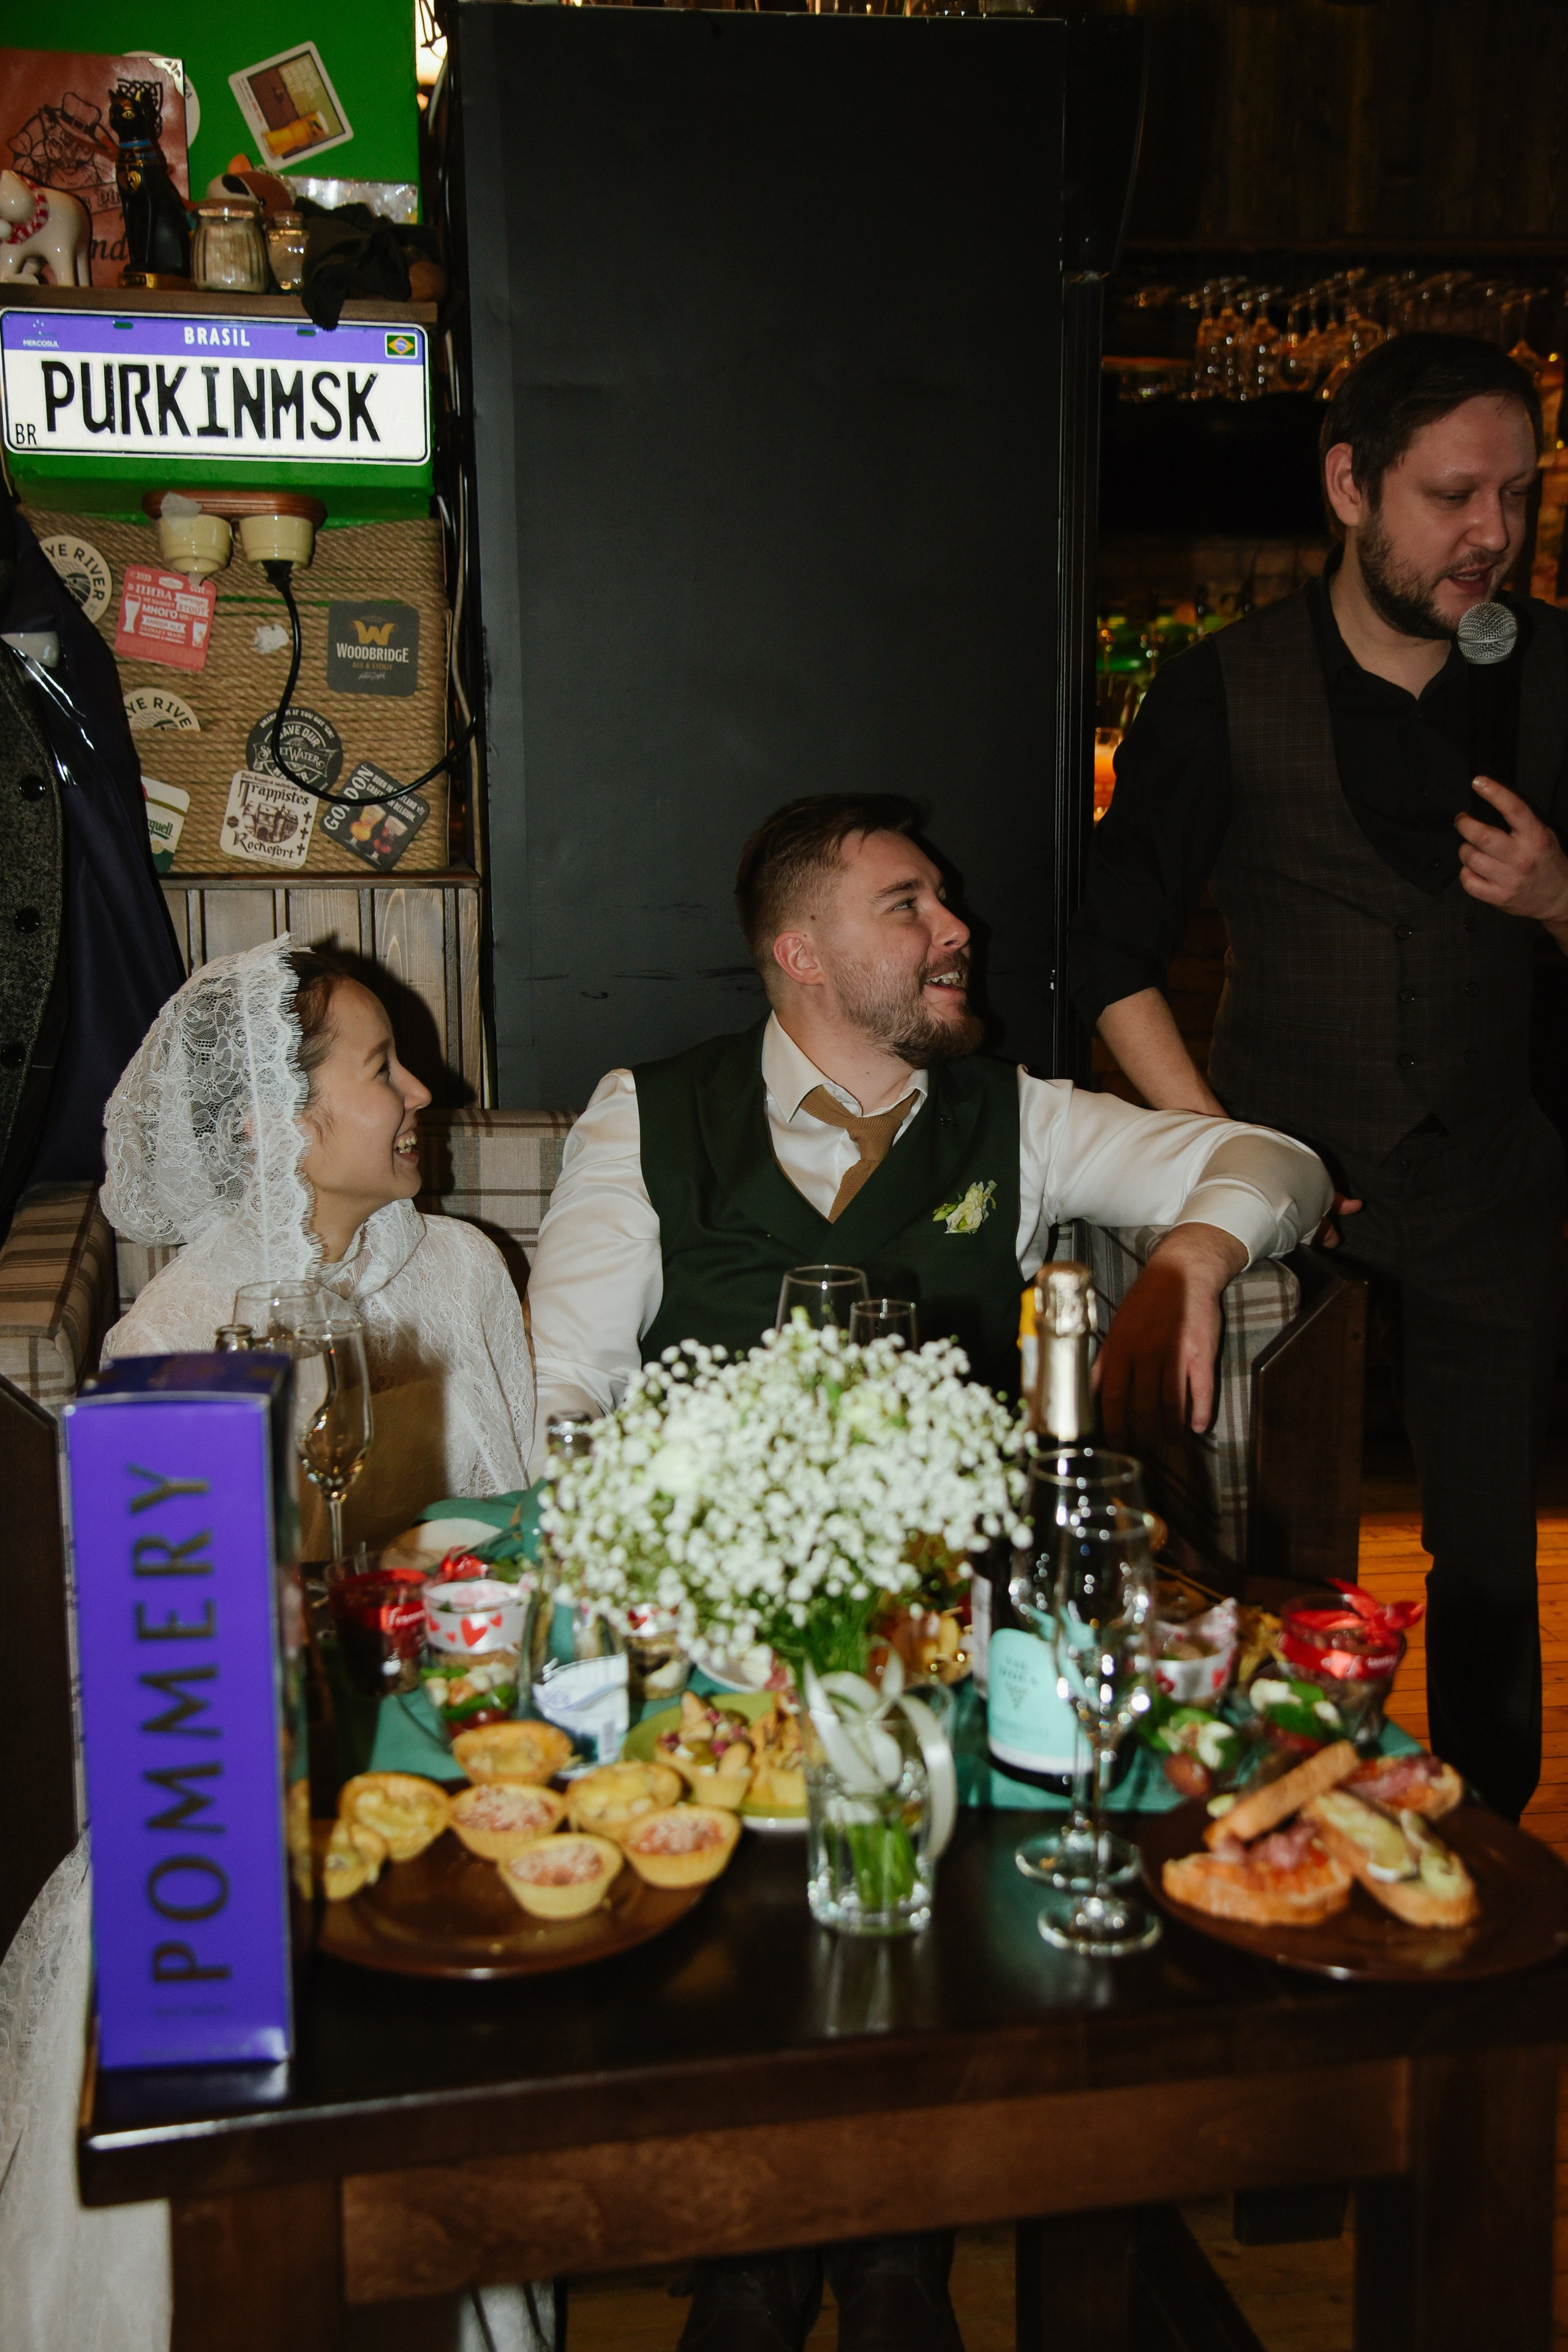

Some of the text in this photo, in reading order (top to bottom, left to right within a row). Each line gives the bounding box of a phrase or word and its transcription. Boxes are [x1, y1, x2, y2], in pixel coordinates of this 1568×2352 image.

[23, 339, 59, 349] MERCOSUL
[184, 326, 251, 347] BRASIL
[40, 360, 381, 442] PURKINMSK
[15, 423, 37, 445] BR
[73, 547, 106, 601] RIVER
[141, 603, 178, 619] МНОГО
[336, 642, 409, 663] WOODBRIDGE
[124, 698, 148, 719] YE
[301, 728, 321, 748] OUR
[372, 774, 388, 790] BORN
[238, 780, 311, 809] Trappistes
[233, 829, 297, 859] Rochefort
[128, 1462, 232, 1985] POMMERY
